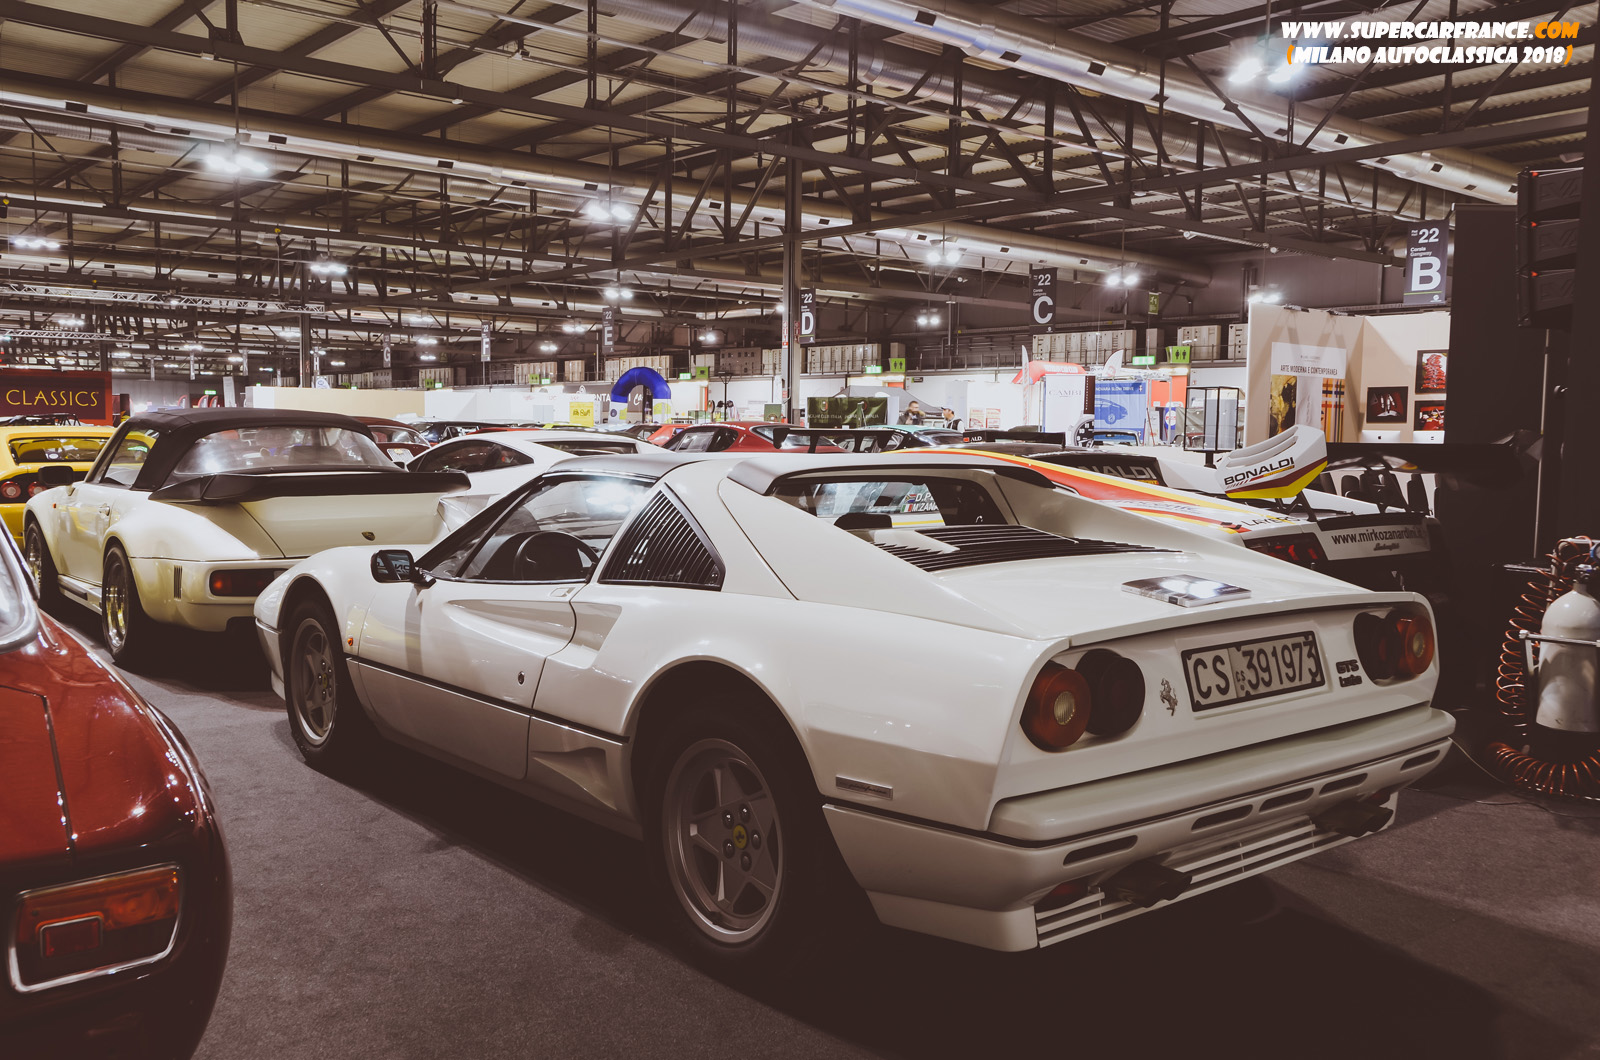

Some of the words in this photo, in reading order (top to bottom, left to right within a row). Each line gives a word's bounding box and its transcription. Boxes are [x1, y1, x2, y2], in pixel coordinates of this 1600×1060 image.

[1418, 227, 1439, 243] 22
[1038, 274, 1051, 286] 22
[1411, 256, 1441, 291] B
[803, 293, 812, 303] 22
[1033, 296, 1053, 324] C
[801, 312, 814, 335] D
[604, 327, 613, 346] E
[383, 347, 391, 361] G
[482, 338, 489, 354] F
[1280, 364, 1290, 372] ARTE
[1290, 365, 1307, 373] MODERNA
[6, 389, 98, 407] CLASSICS
[1224, 457, 1295, 485] BONALDI
[1193, 654, 1230, 700] CS
[1242, 641, 1320, 691] 391973
